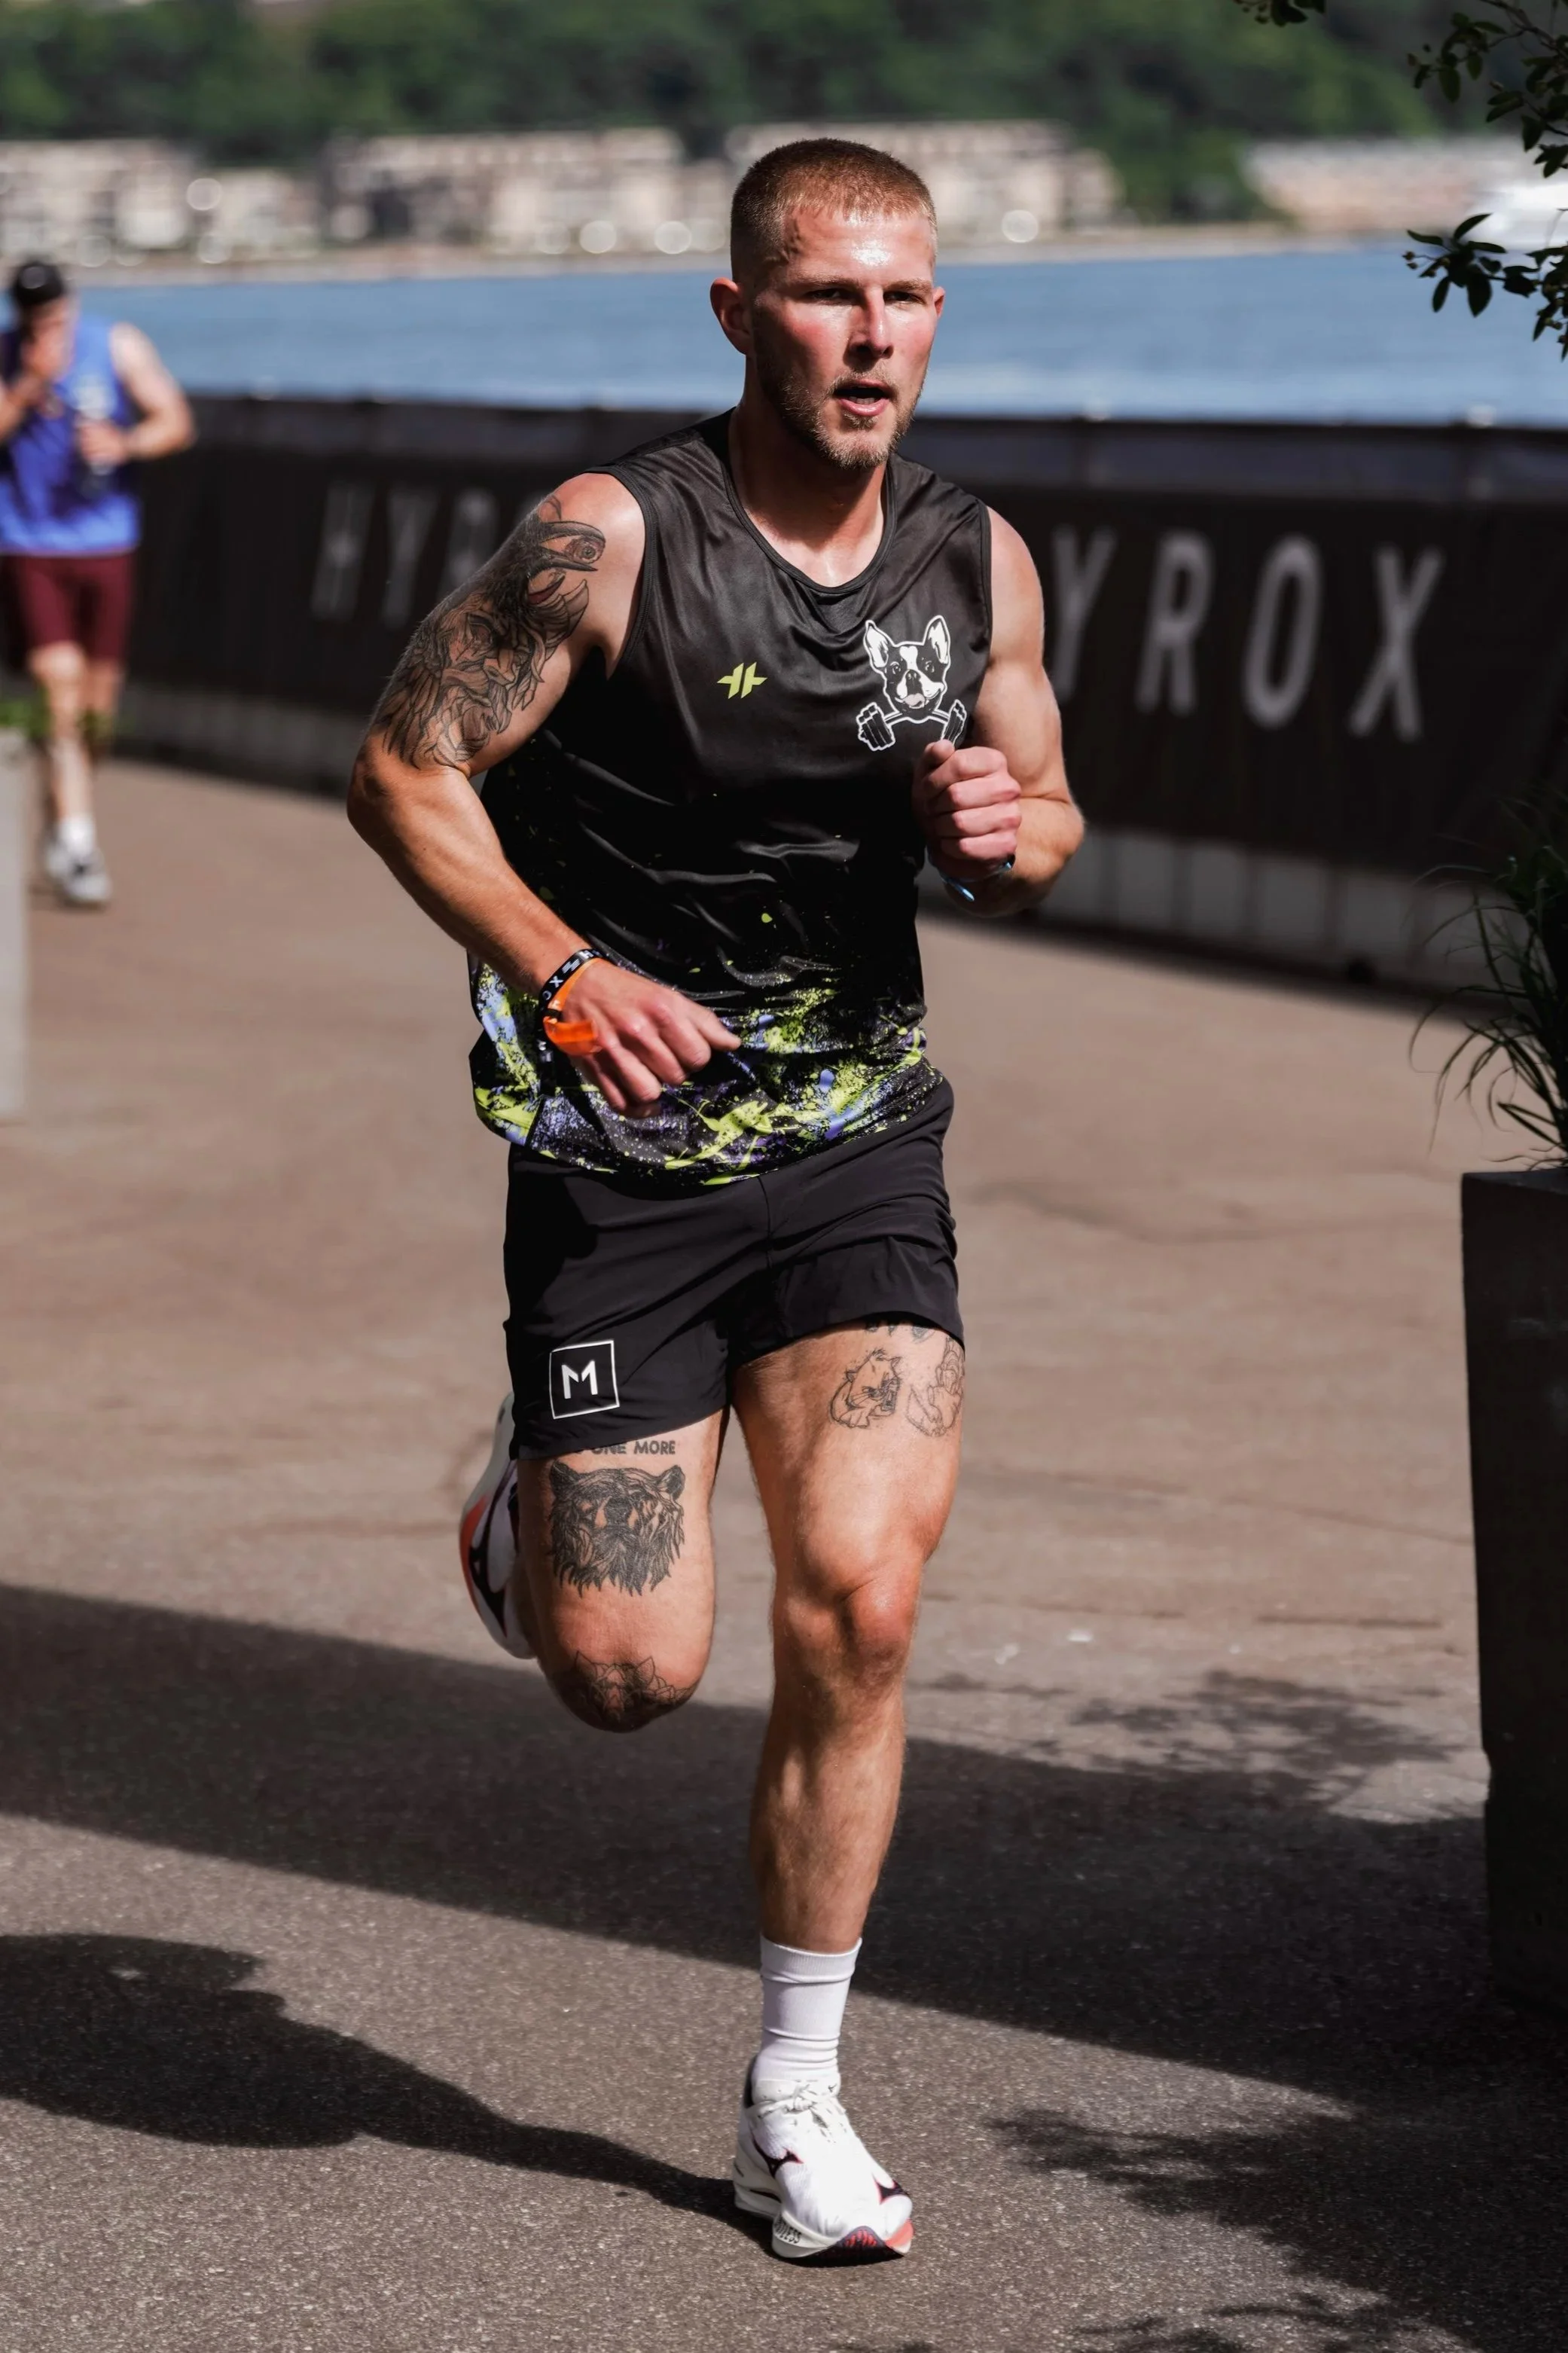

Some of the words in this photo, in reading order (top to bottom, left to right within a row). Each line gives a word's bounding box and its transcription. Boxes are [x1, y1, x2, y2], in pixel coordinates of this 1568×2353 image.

[310, 481, 527, 628] HYR
[1051, 525, 1444, 742] YROX
[562, 1360, 598, 1399] M
[633, 1439, 676, 1455] MORE
